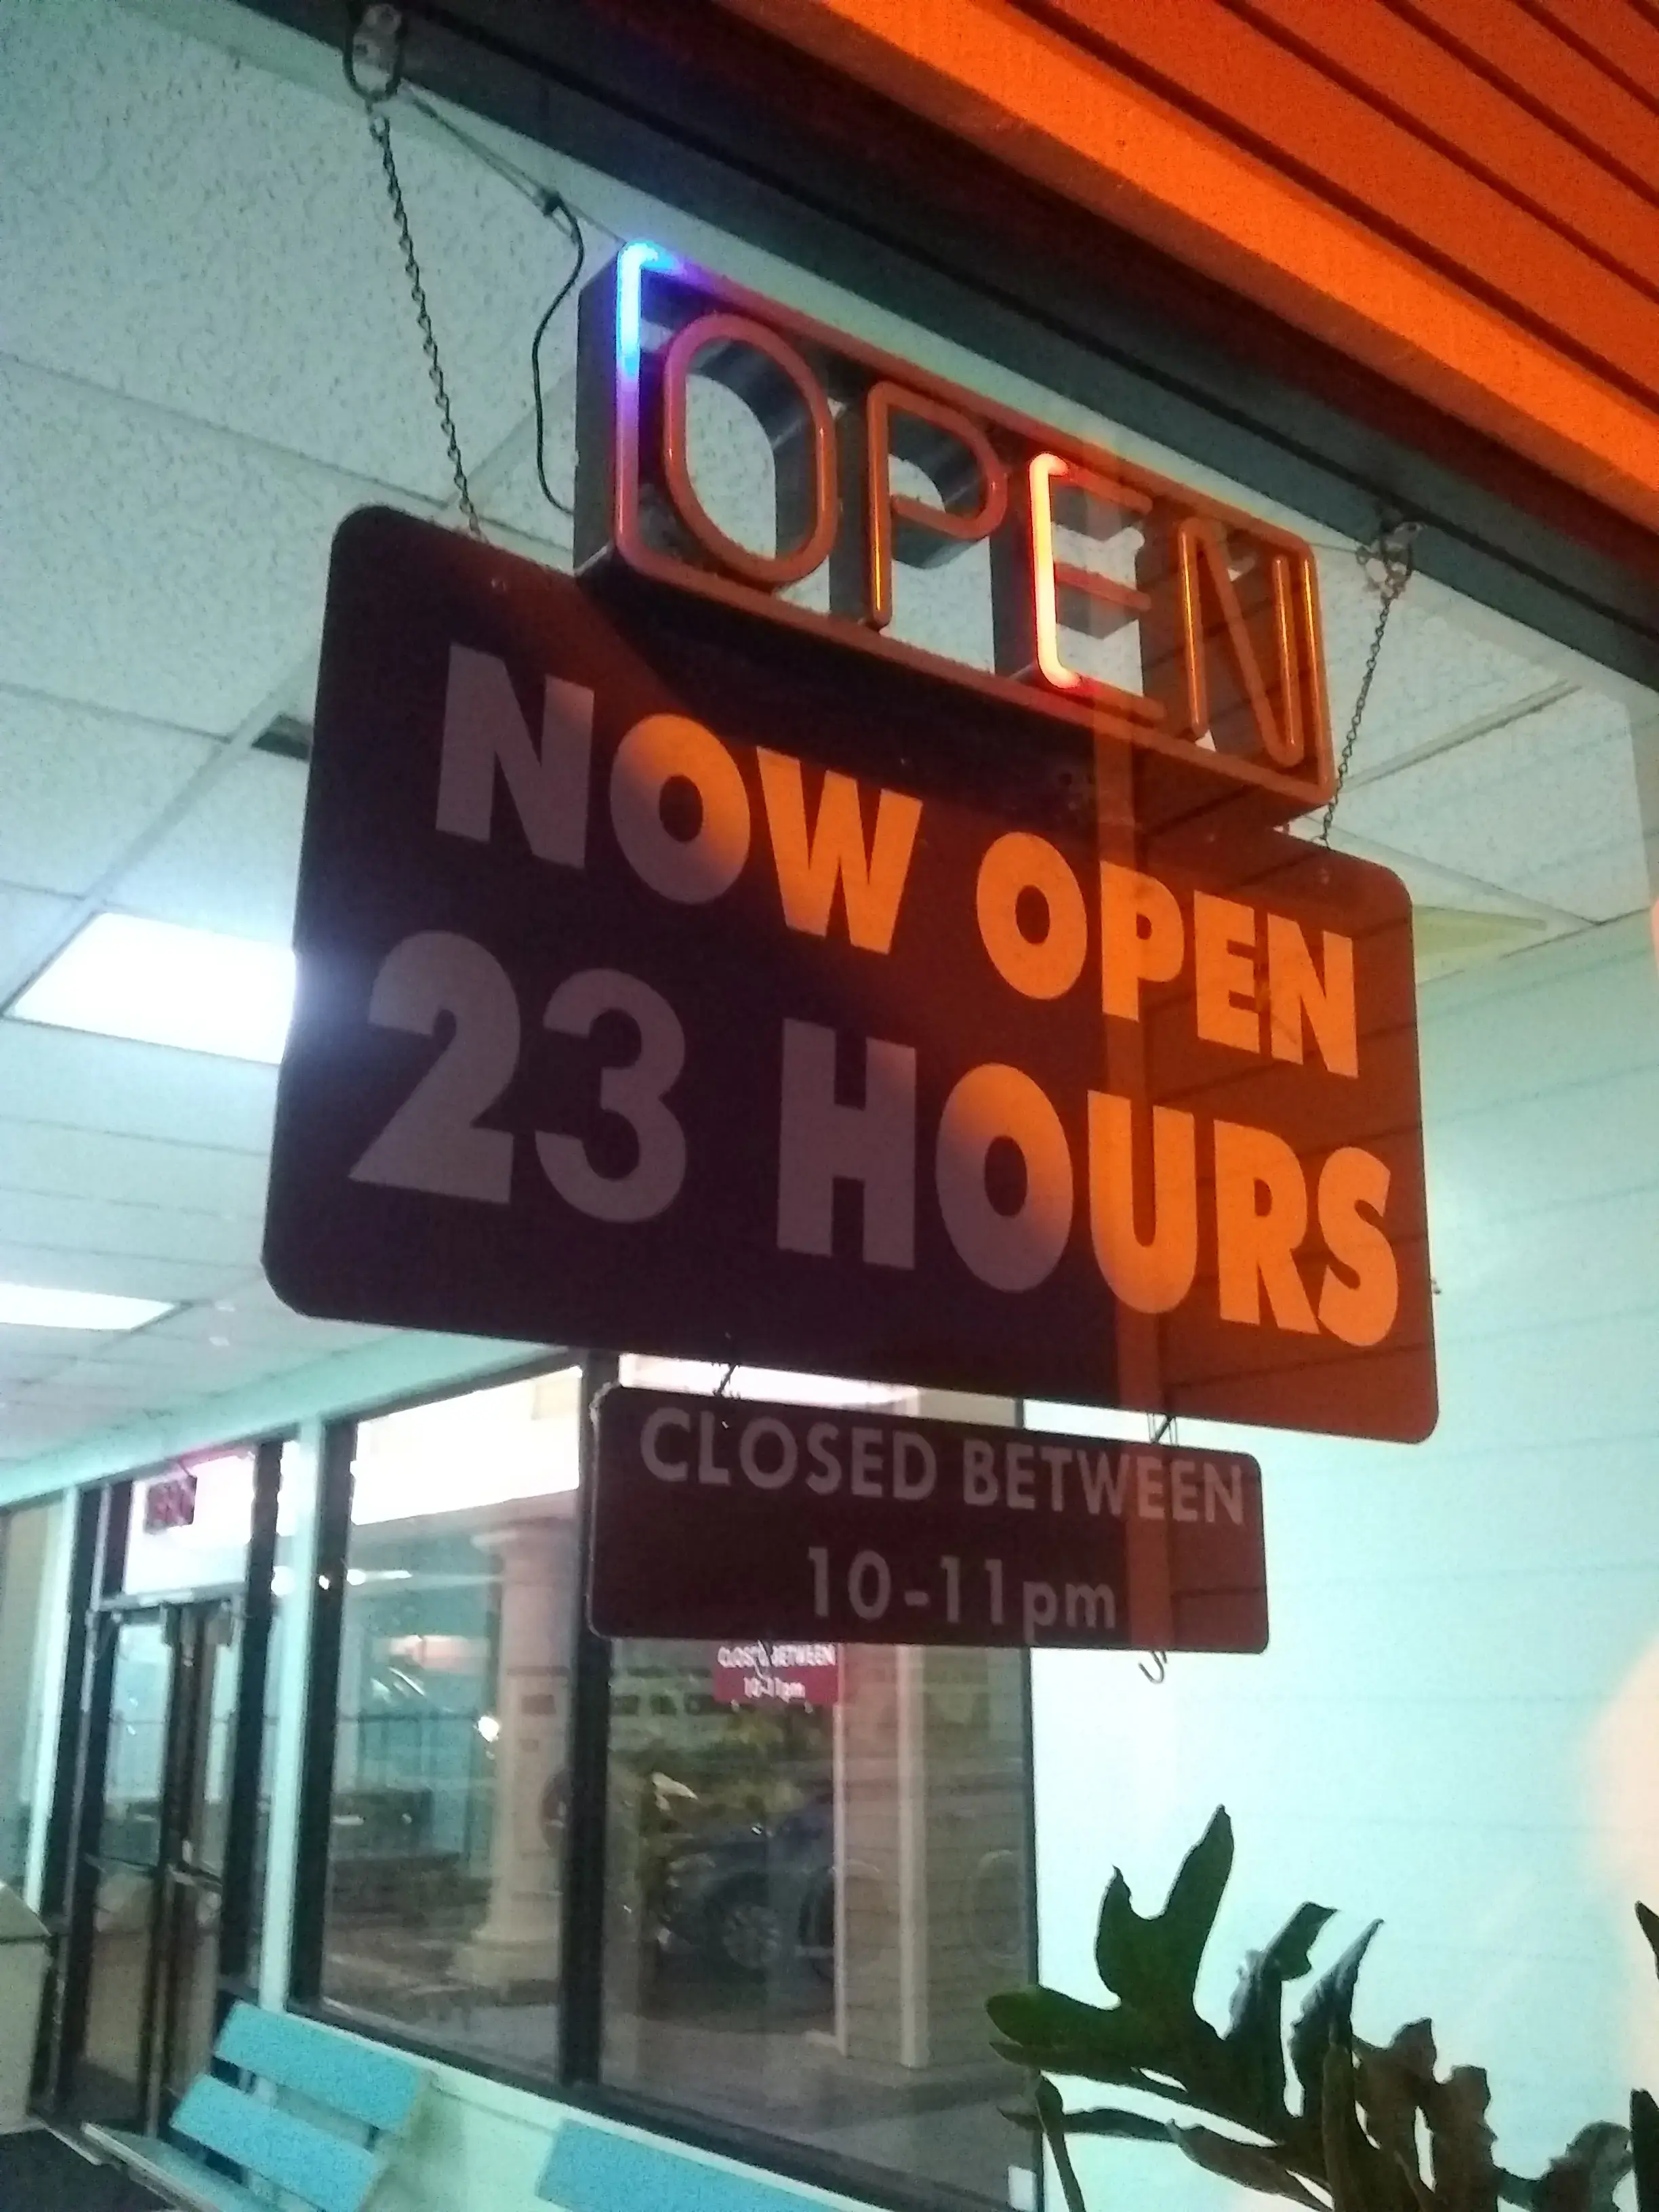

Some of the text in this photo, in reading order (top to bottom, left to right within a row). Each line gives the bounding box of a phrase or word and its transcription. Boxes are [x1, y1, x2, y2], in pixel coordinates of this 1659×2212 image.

[662, 312, 1304, 769] OPEN
[435, 642, 1359, 1079] NOW OPEN
[348, 930, 1399, 1347] 23 HOURS
[640, 1407, 1244, 1525] CLOSED BETWEEN
[808, 1546, 1117, 1647] 10-11pm
